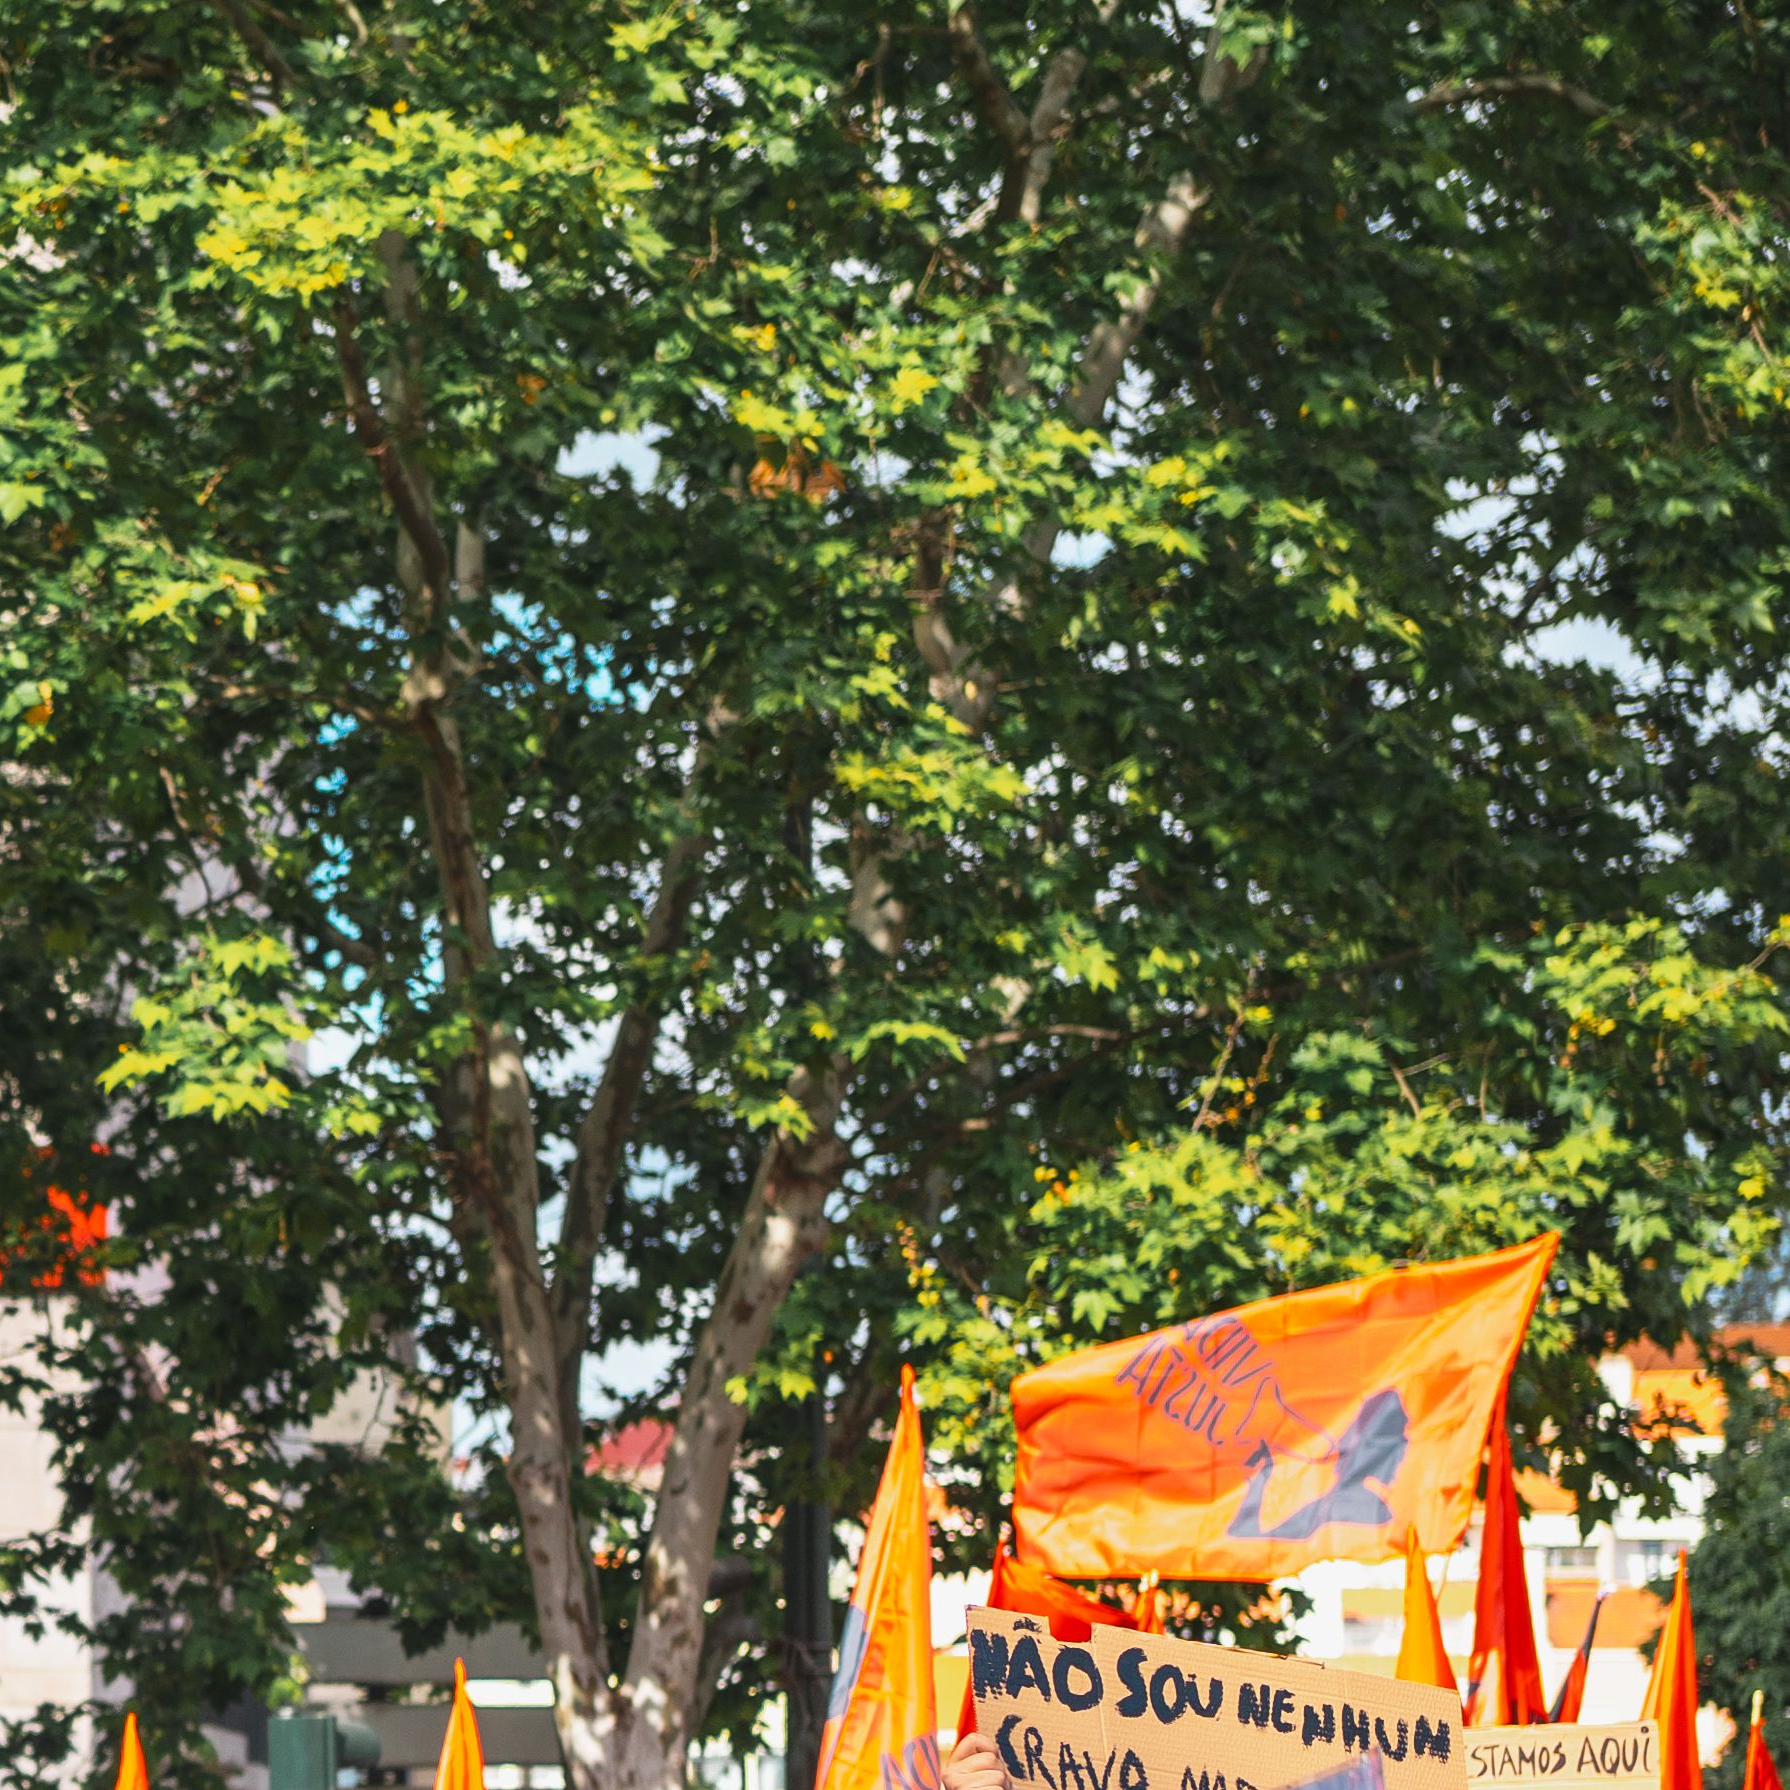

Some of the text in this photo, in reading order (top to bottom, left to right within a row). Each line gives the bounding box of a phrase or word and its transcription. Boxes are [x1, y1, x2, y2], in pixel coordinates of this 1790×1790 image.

[969, 1616, 1103, 1712] NÃO
[1114, 1646, 1224, 1725] SOU
[1465, 1741, 1567, 1779] STAMOS
